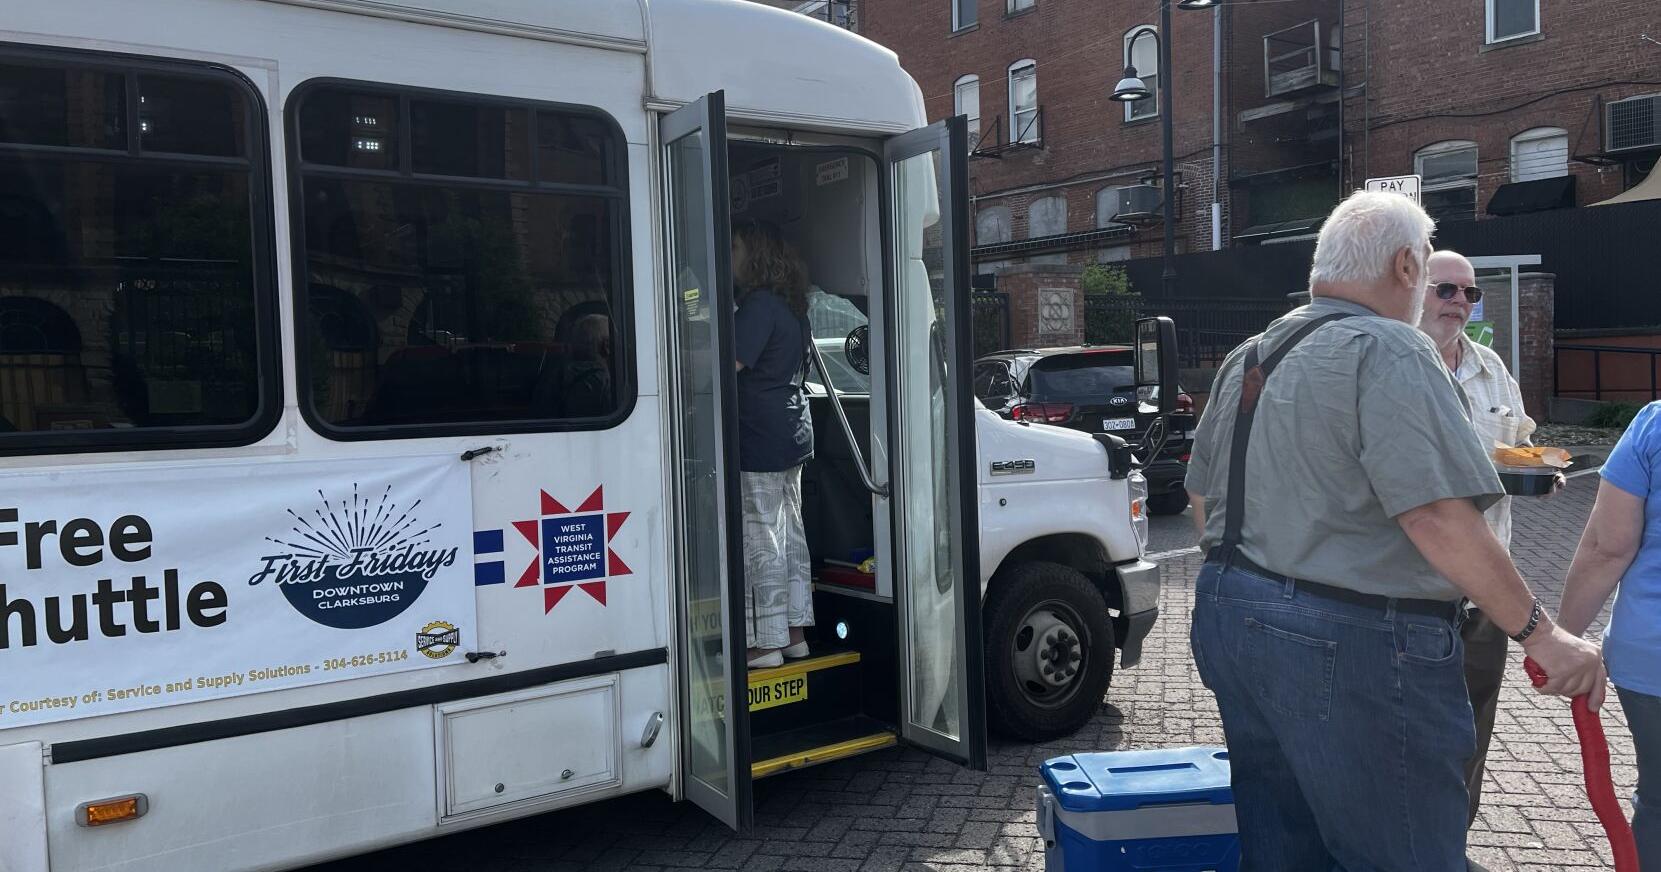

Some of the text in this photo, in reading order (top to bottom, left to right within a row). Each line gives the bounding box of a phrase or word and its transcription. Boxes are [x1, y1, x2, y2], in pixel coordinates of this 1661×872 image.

[1380, 180, 1405, 192] PAY
[561, 523, 586, 533] WEST
[553, 533, 593, 544] VIRGINIA
[555, 543, 593, 554] TRANSIT
[249, 543, 459, 586] First Fridays
[548, 552, 601, 565] ASSISTANCE
[552, 563, 597, 575] PROGRAM
[313, 581, 404, 599] DOWNTOWN
[0, 568, 229, 650] huttle
[318, 594, 400, 610] CLARKSBURG
[9, 695, 78, 713] Courtesy
[82, 690, 102, 704] of:
[107, 684, 162, 701] Service
[166, 678, 193, 693] and
[197, 672, 245, 689] Supply
[249, 664, 311, 682] Solutions
[323, 649, 408, 672] 304-626-5114
[748, 685, 771, 705] OUR
[775, 678, 803, 700] STEP
